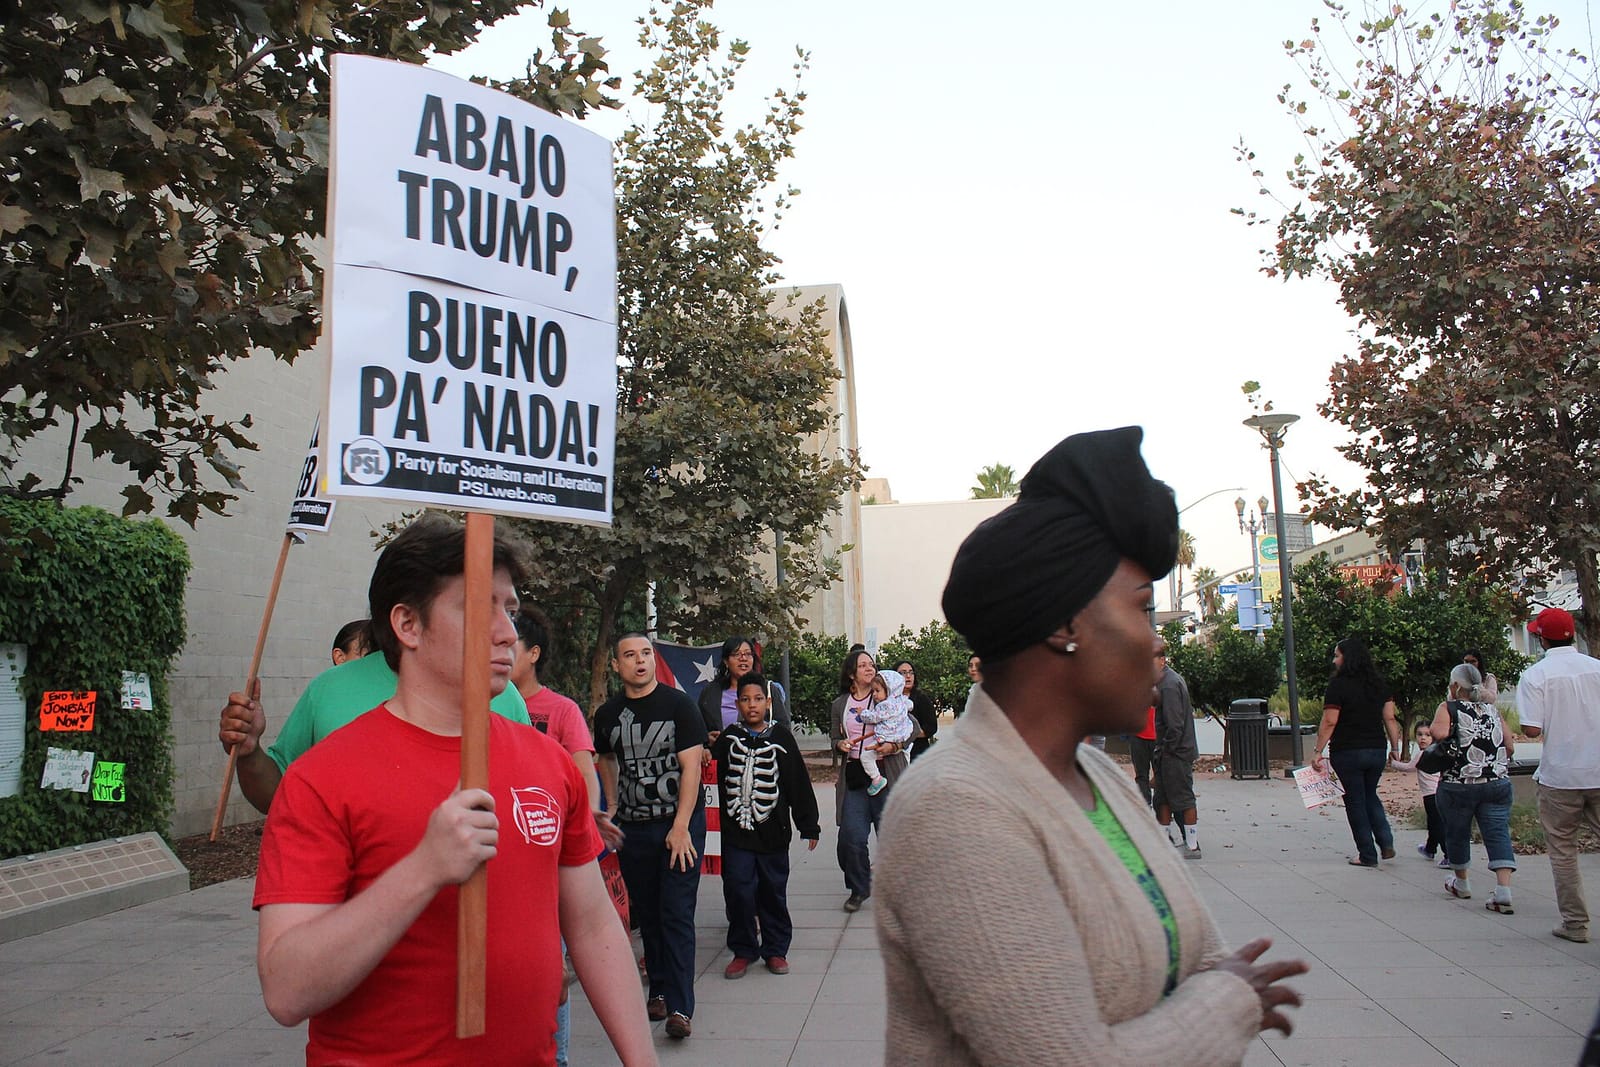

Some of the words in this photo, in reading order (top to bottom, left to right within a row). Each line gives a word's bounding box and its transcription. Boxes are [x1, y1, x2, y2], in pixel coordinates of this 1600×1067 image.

[415, 94, 566, 199] ABAJO
[398, 169, 579, 292] TRUMP,
[408, 290, 567, 388] BUENO
[463, 381, 600, 467] NADA!
[350, 454, 384, 475] PSL
[395, 452, 435, 475] Party
[437, 456, 460, 475] for
[460, 459, 521, 485] Socialism
[523, 470, 546, 487] and
[548, 472, 603, 495] Liberation
[49, 692, 68, 701] END
[56, 714, 91, 729] NOW!
[625, 753, 679, 777] ERTO
